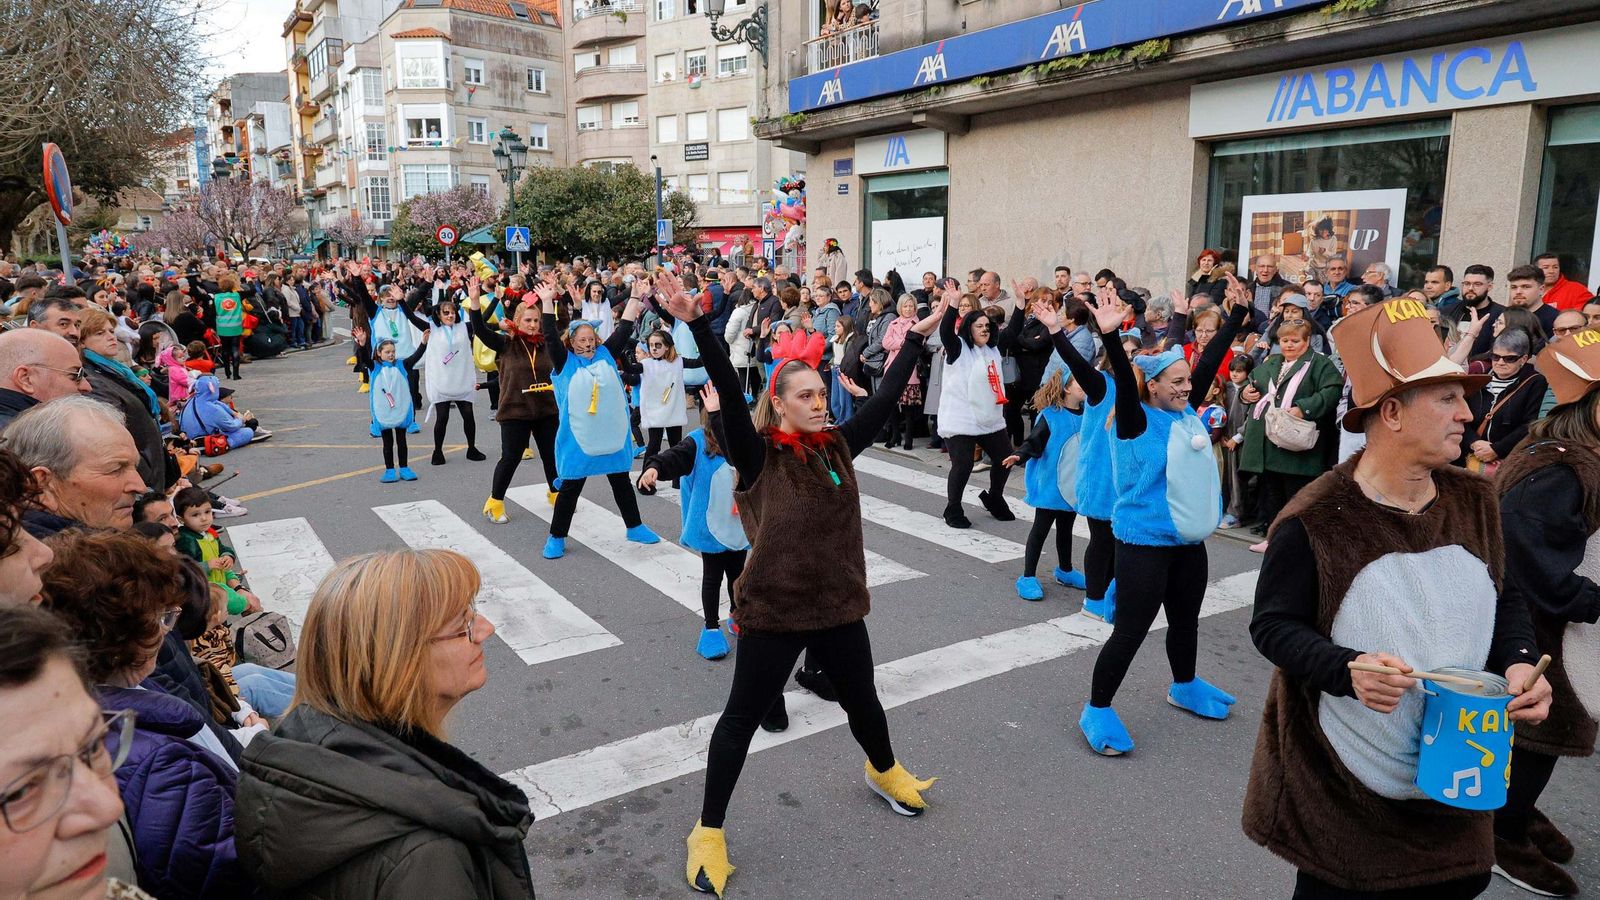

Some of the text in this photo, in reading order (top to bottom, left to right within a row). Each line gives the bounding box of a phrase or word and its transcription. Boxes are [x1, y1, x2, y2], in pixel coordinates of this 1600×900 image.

[1041, 19, 1087, 58] AXA
[913, 53, 948, 85] AXA
[1287, 40, 1538, 121] ABANCA
[817, 78, 844, 105] AXA
[441, 231, 453, 239] 30
[1350, 229, 1380, 250] UP
